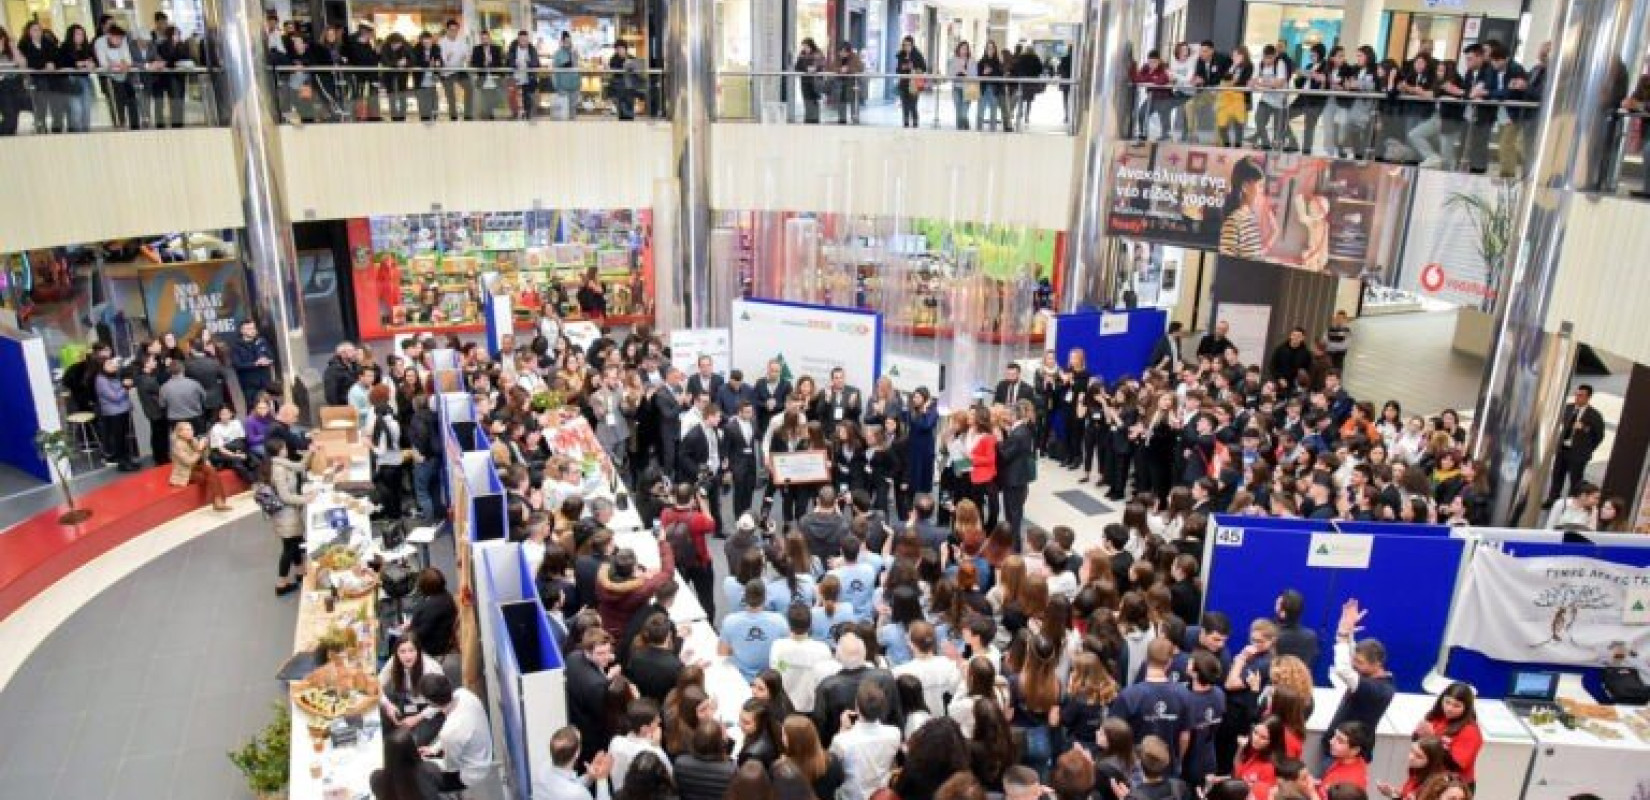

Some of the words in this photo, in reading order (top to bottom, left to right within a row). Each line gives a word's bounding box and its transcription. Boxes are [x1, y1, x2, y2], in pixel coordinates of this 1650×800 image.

[1116, 165, 1199, 187] Ανακάλυψε
[1200, 173, 1225, 189] ένα
[1116, 182, 1140, 198] νέο
[1181, 189, 1225, 208] χορού
[180, 293, 223, 311] TIME
[206, 318, 236, 333] DIE
[1219, 528, 1240, 543] 45
